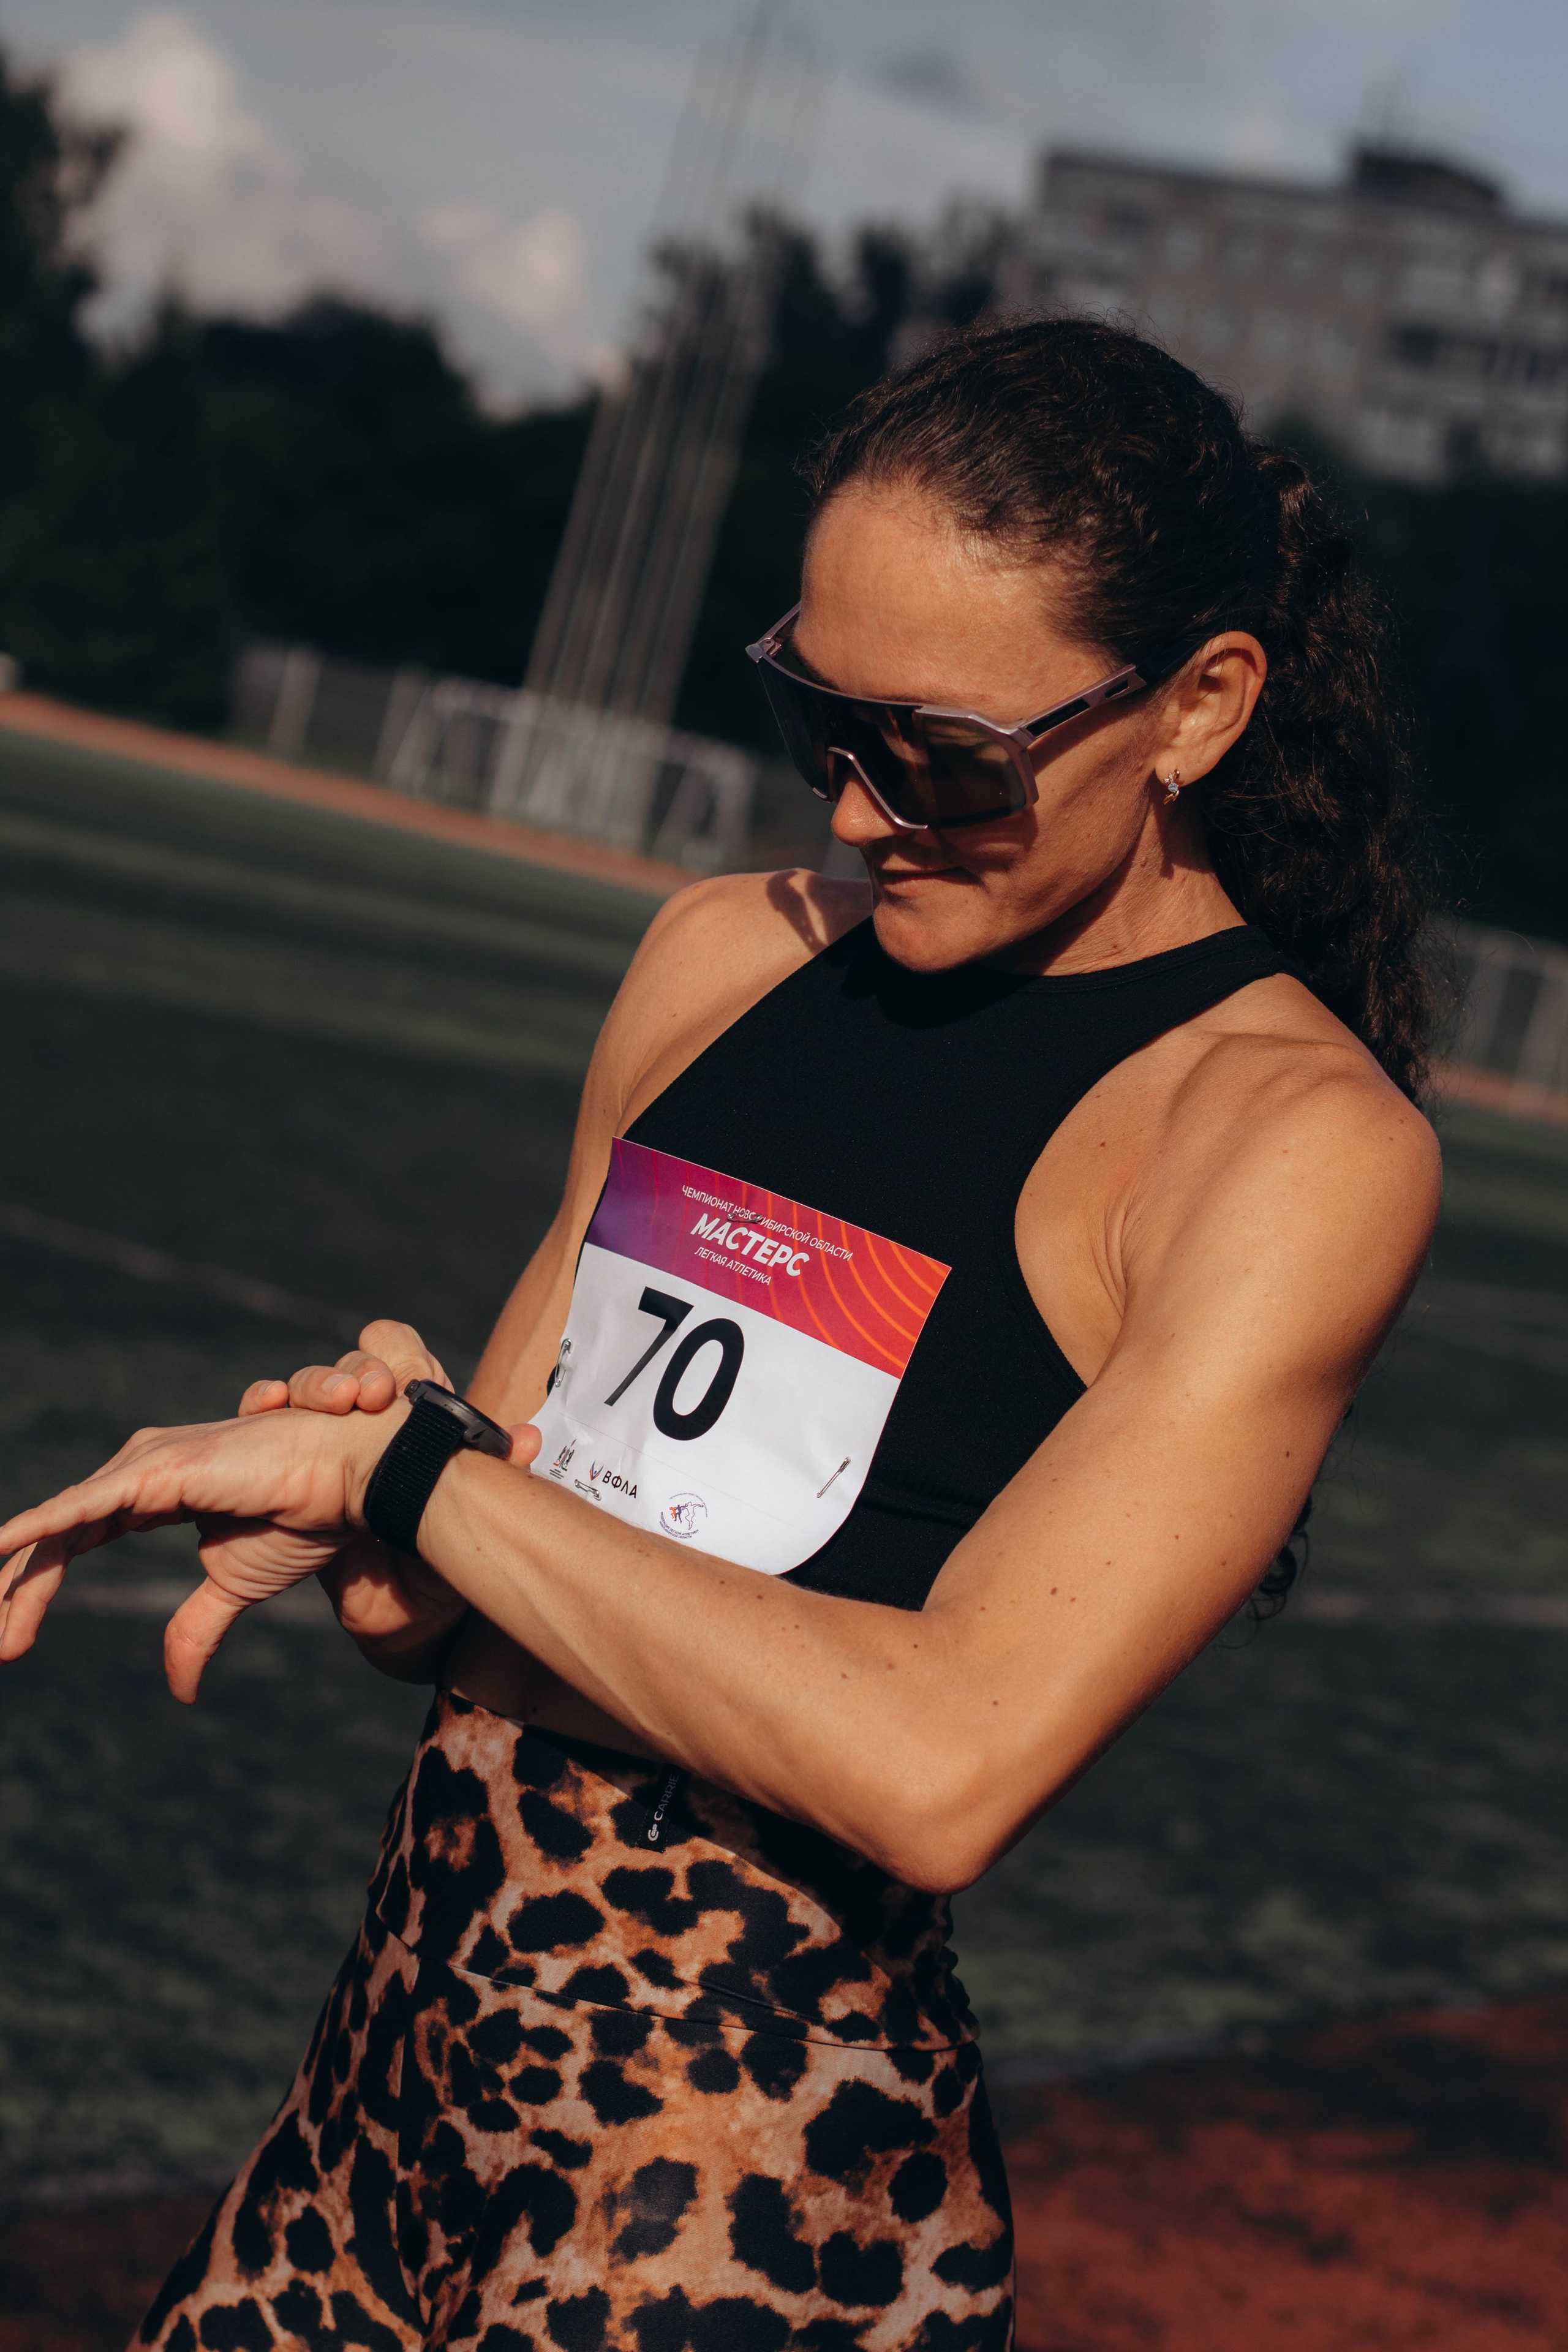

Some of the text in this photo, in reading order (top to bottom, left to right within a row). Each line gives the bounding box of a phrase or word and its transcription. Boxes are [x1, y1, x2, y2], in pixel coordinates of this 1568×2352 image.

[682, 1185, 853, 1262] ЧЕМПИОНАТ НОВОИБИРСКОЙ ОБЛАСТИ
[690, 1213, 810, 1276] МАСТЕРС
[695, 1247, 772, 1286] ЛЕГКАЯ АТЛЕТИКА
[603, 1286, 745, 1441] 70
[602, 1471, 638, 1499] ВФЛА
